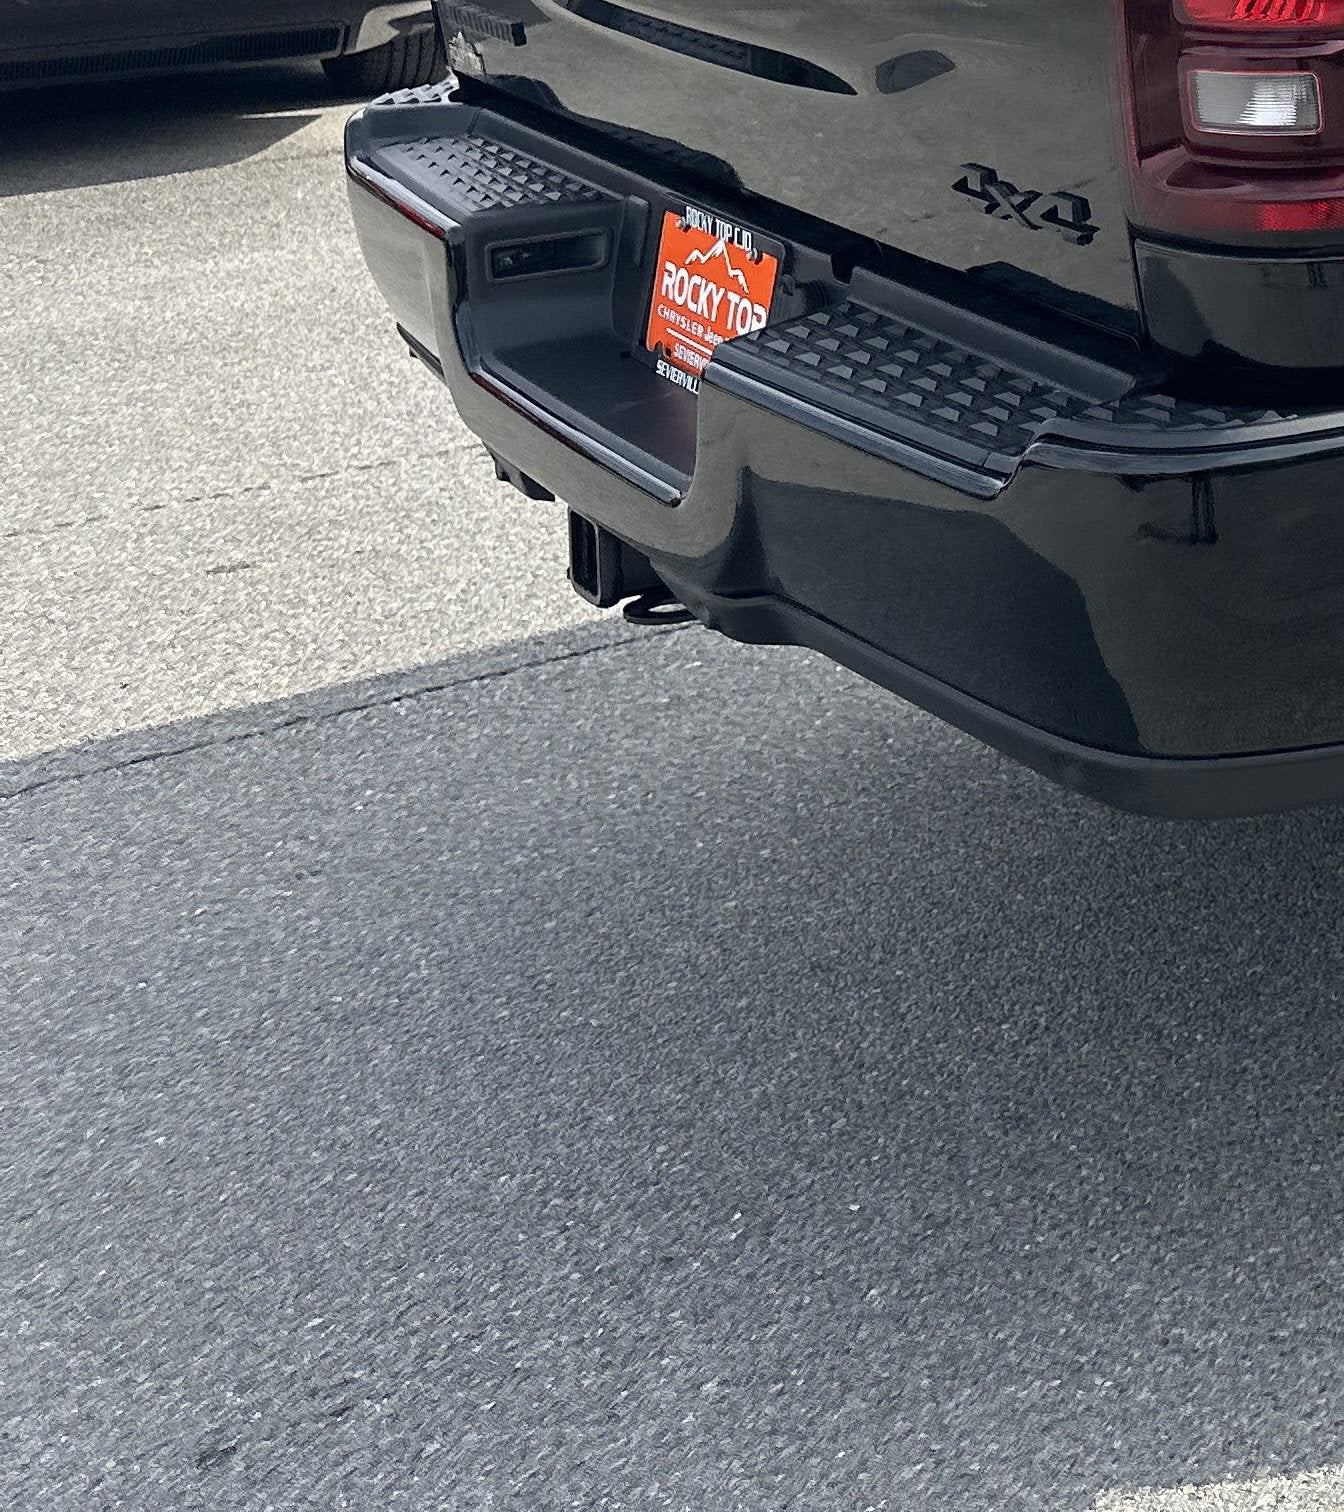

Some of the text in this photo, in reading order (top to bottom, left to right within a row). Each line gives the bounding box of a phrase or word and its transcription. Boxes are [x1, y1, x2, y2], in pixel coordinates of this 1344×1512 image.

[685, 205, 752, 253] ROCKY TOP CJD
[657, 303, 705, 339] CHRYSLER
[661, 260, 767, 336] ROCKY TOP
